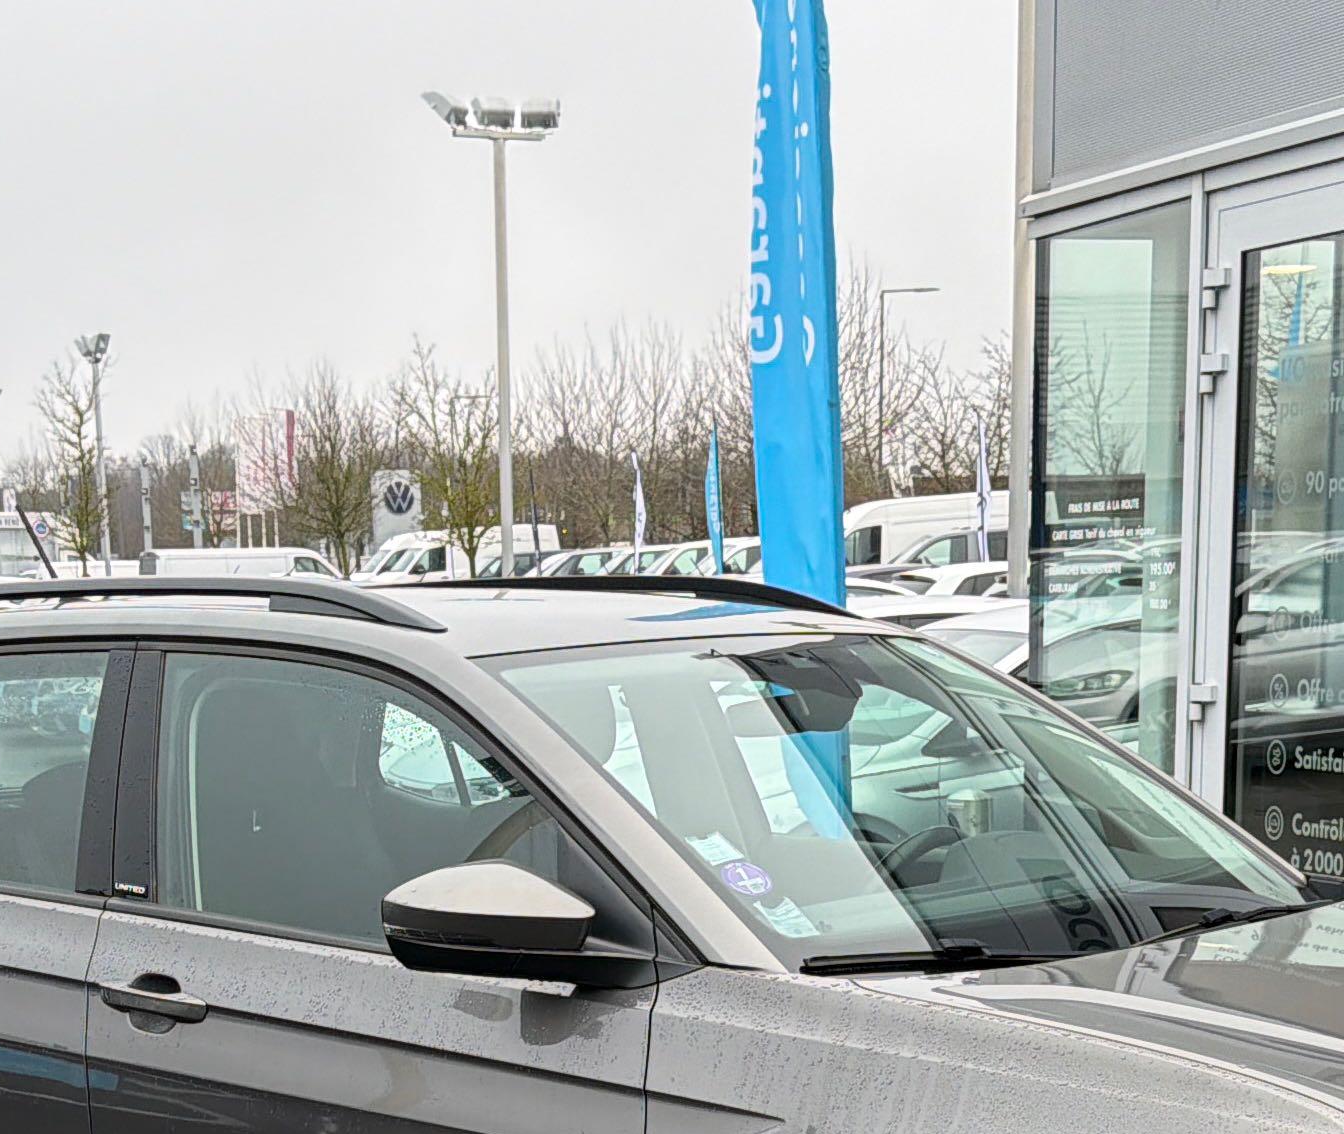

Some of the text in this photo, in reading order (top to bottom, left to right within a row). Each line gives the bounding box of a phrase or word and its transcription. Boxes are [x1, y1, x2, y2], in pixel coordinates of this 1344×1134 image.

[1306, 469, 1324, 495] 90
[1297, 678, 1334, 702] Offre
[1291, 847, 1301, 871] à
[114, 882, 146, 895] UNITED
